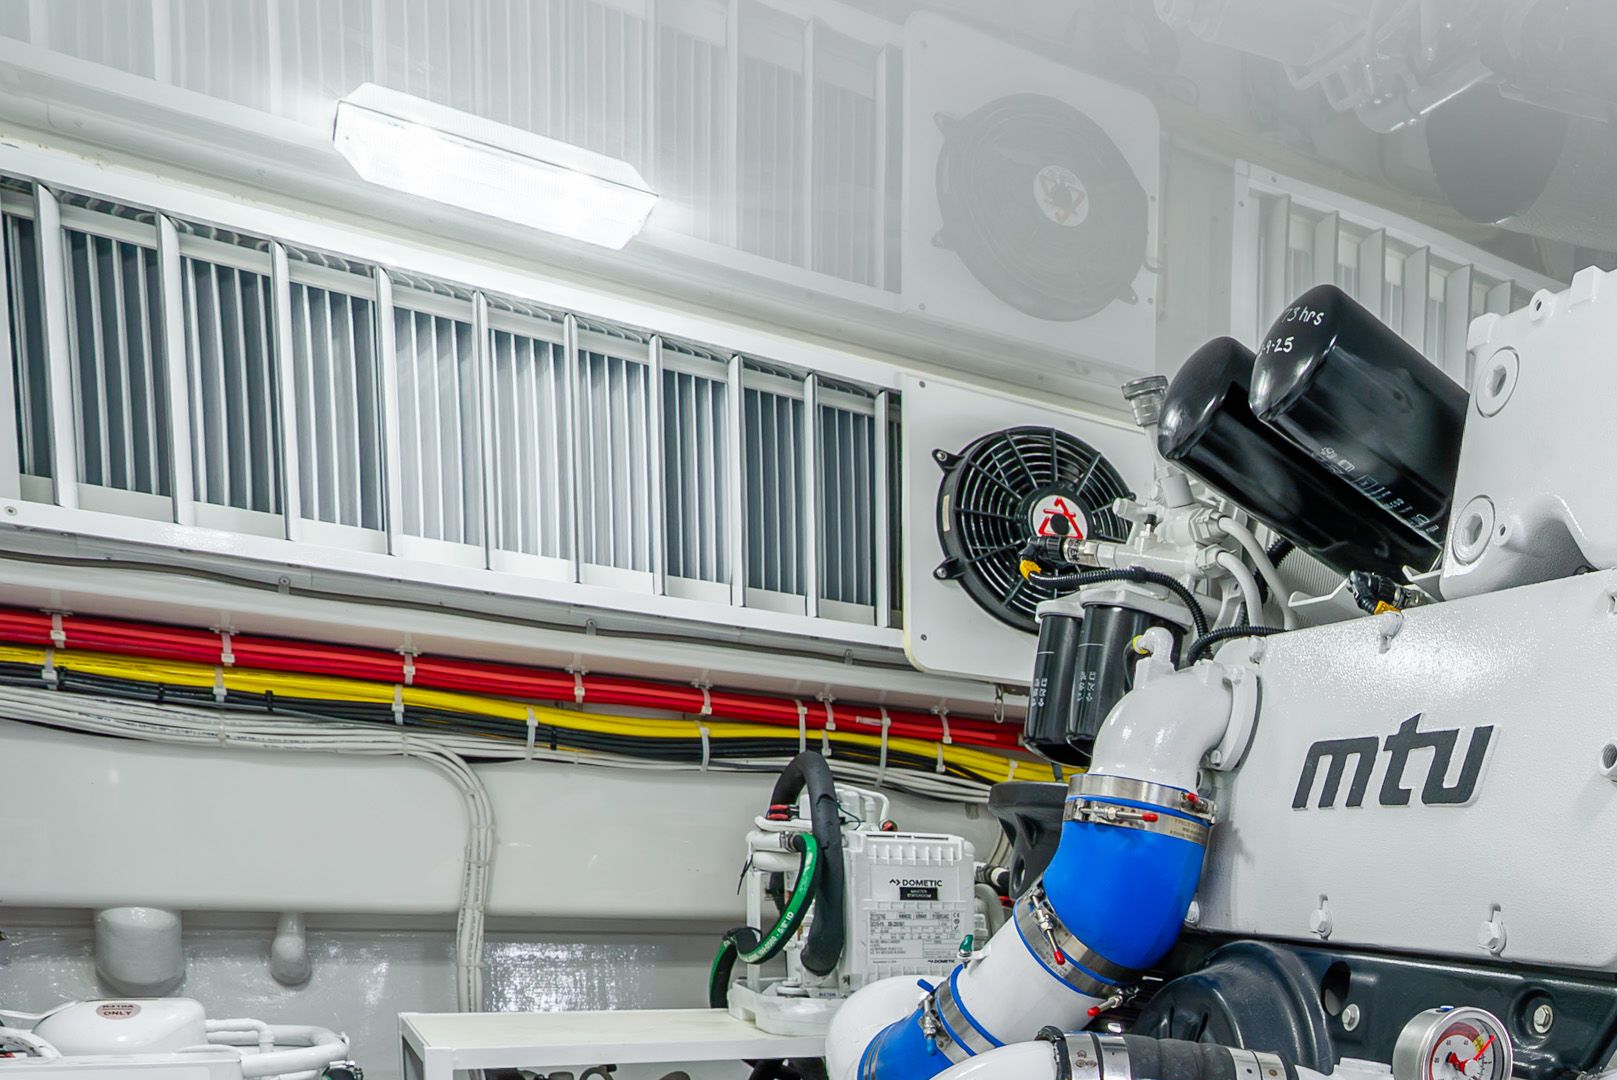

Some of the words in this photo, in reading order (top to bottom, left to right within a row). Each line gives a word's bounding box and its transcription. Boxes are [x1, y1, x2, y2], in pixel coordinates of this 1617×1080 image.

[1299, 306, 1325, 326] hrs
[1291, 712, 1495, 809] mtu
[902, 879, 943, 887] DOMETIC
